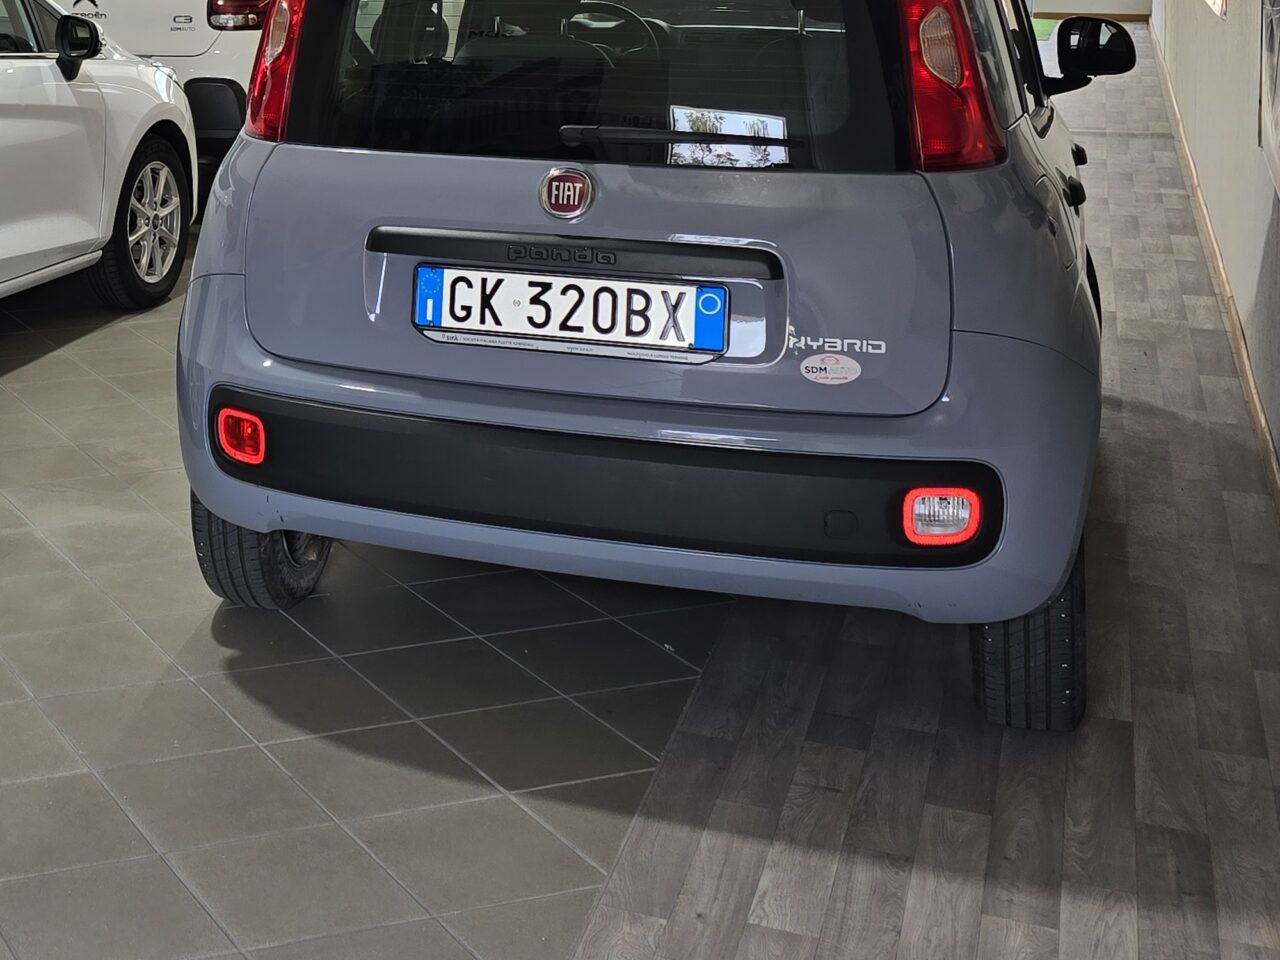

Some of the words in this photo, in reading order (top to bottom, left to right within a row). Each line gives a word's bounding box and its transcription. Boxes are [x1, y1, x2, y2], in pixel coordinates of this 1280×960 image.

[172, 15, 193, 24] C3
[551, 181, 583, 205] FIAT
[507, 243, 618, 266] panda
[448, 275, 506, 327] GK
[526, 280, 688, 342] 320BX
